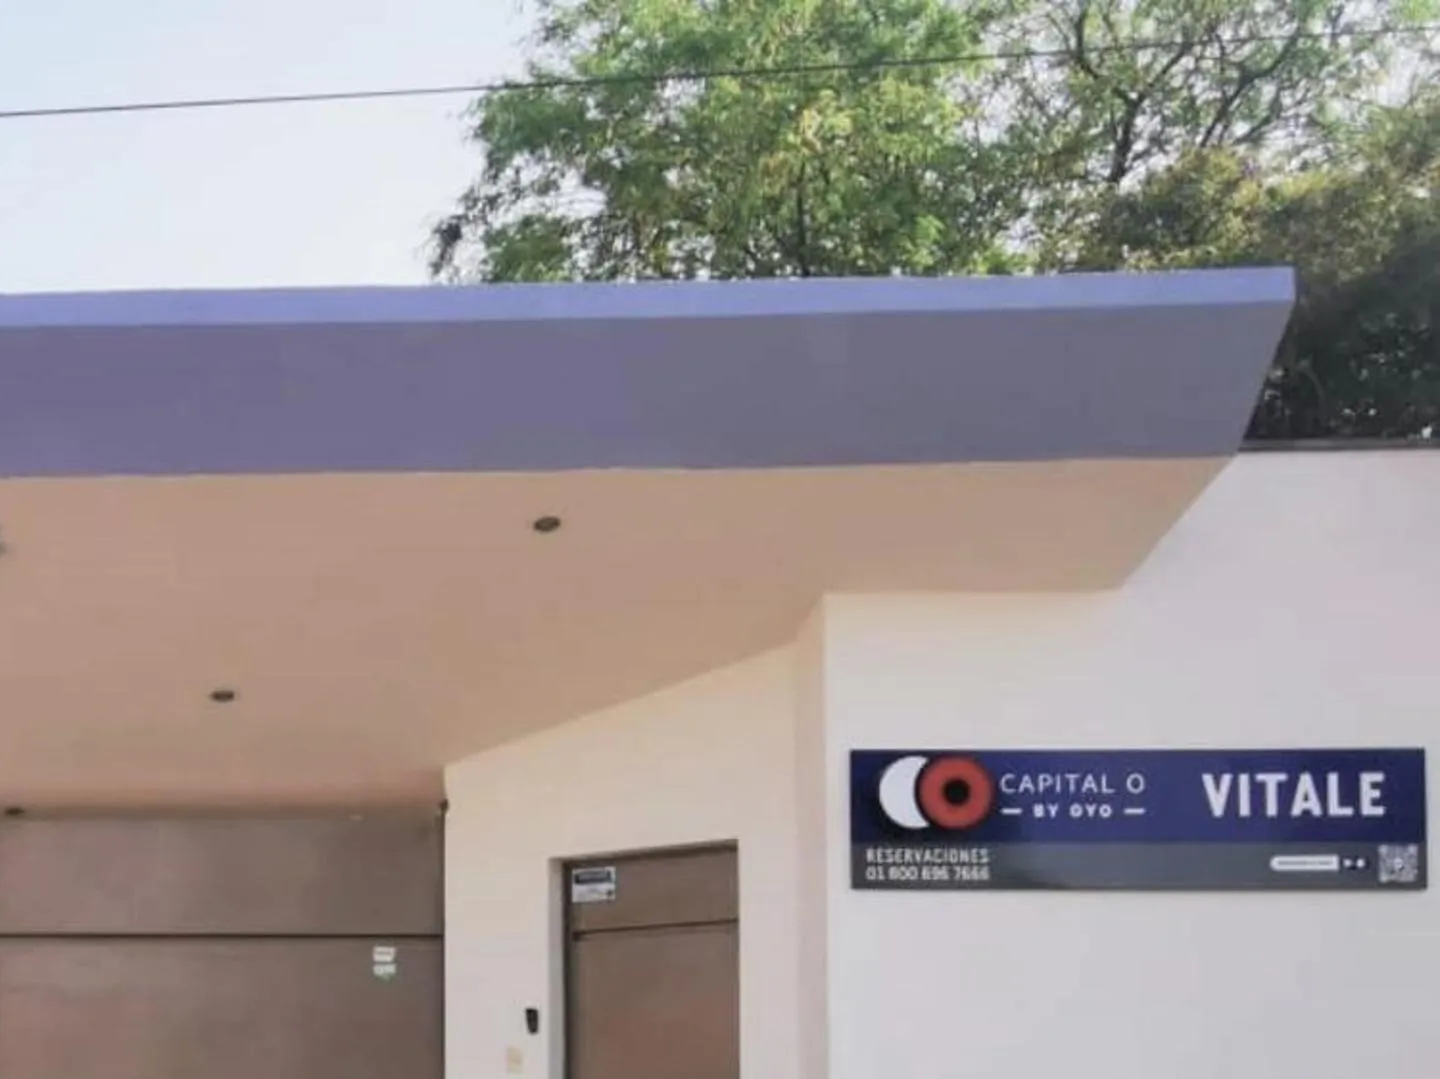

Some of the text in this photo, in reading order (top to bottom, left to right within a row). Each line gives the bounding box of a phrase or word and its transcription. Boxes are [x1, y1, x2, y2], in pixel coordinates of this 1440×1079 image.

[1000, 772, 1146, 794] CAPITAL O
[1201, 771, 1387, 818] VITALE
[1032, 803, 1112, 818] BY OYO
[866, 848, 989, 864] RESERVACIONES
[865, 865, 885, 880] 01
[888, 865, 919, 880] 800
